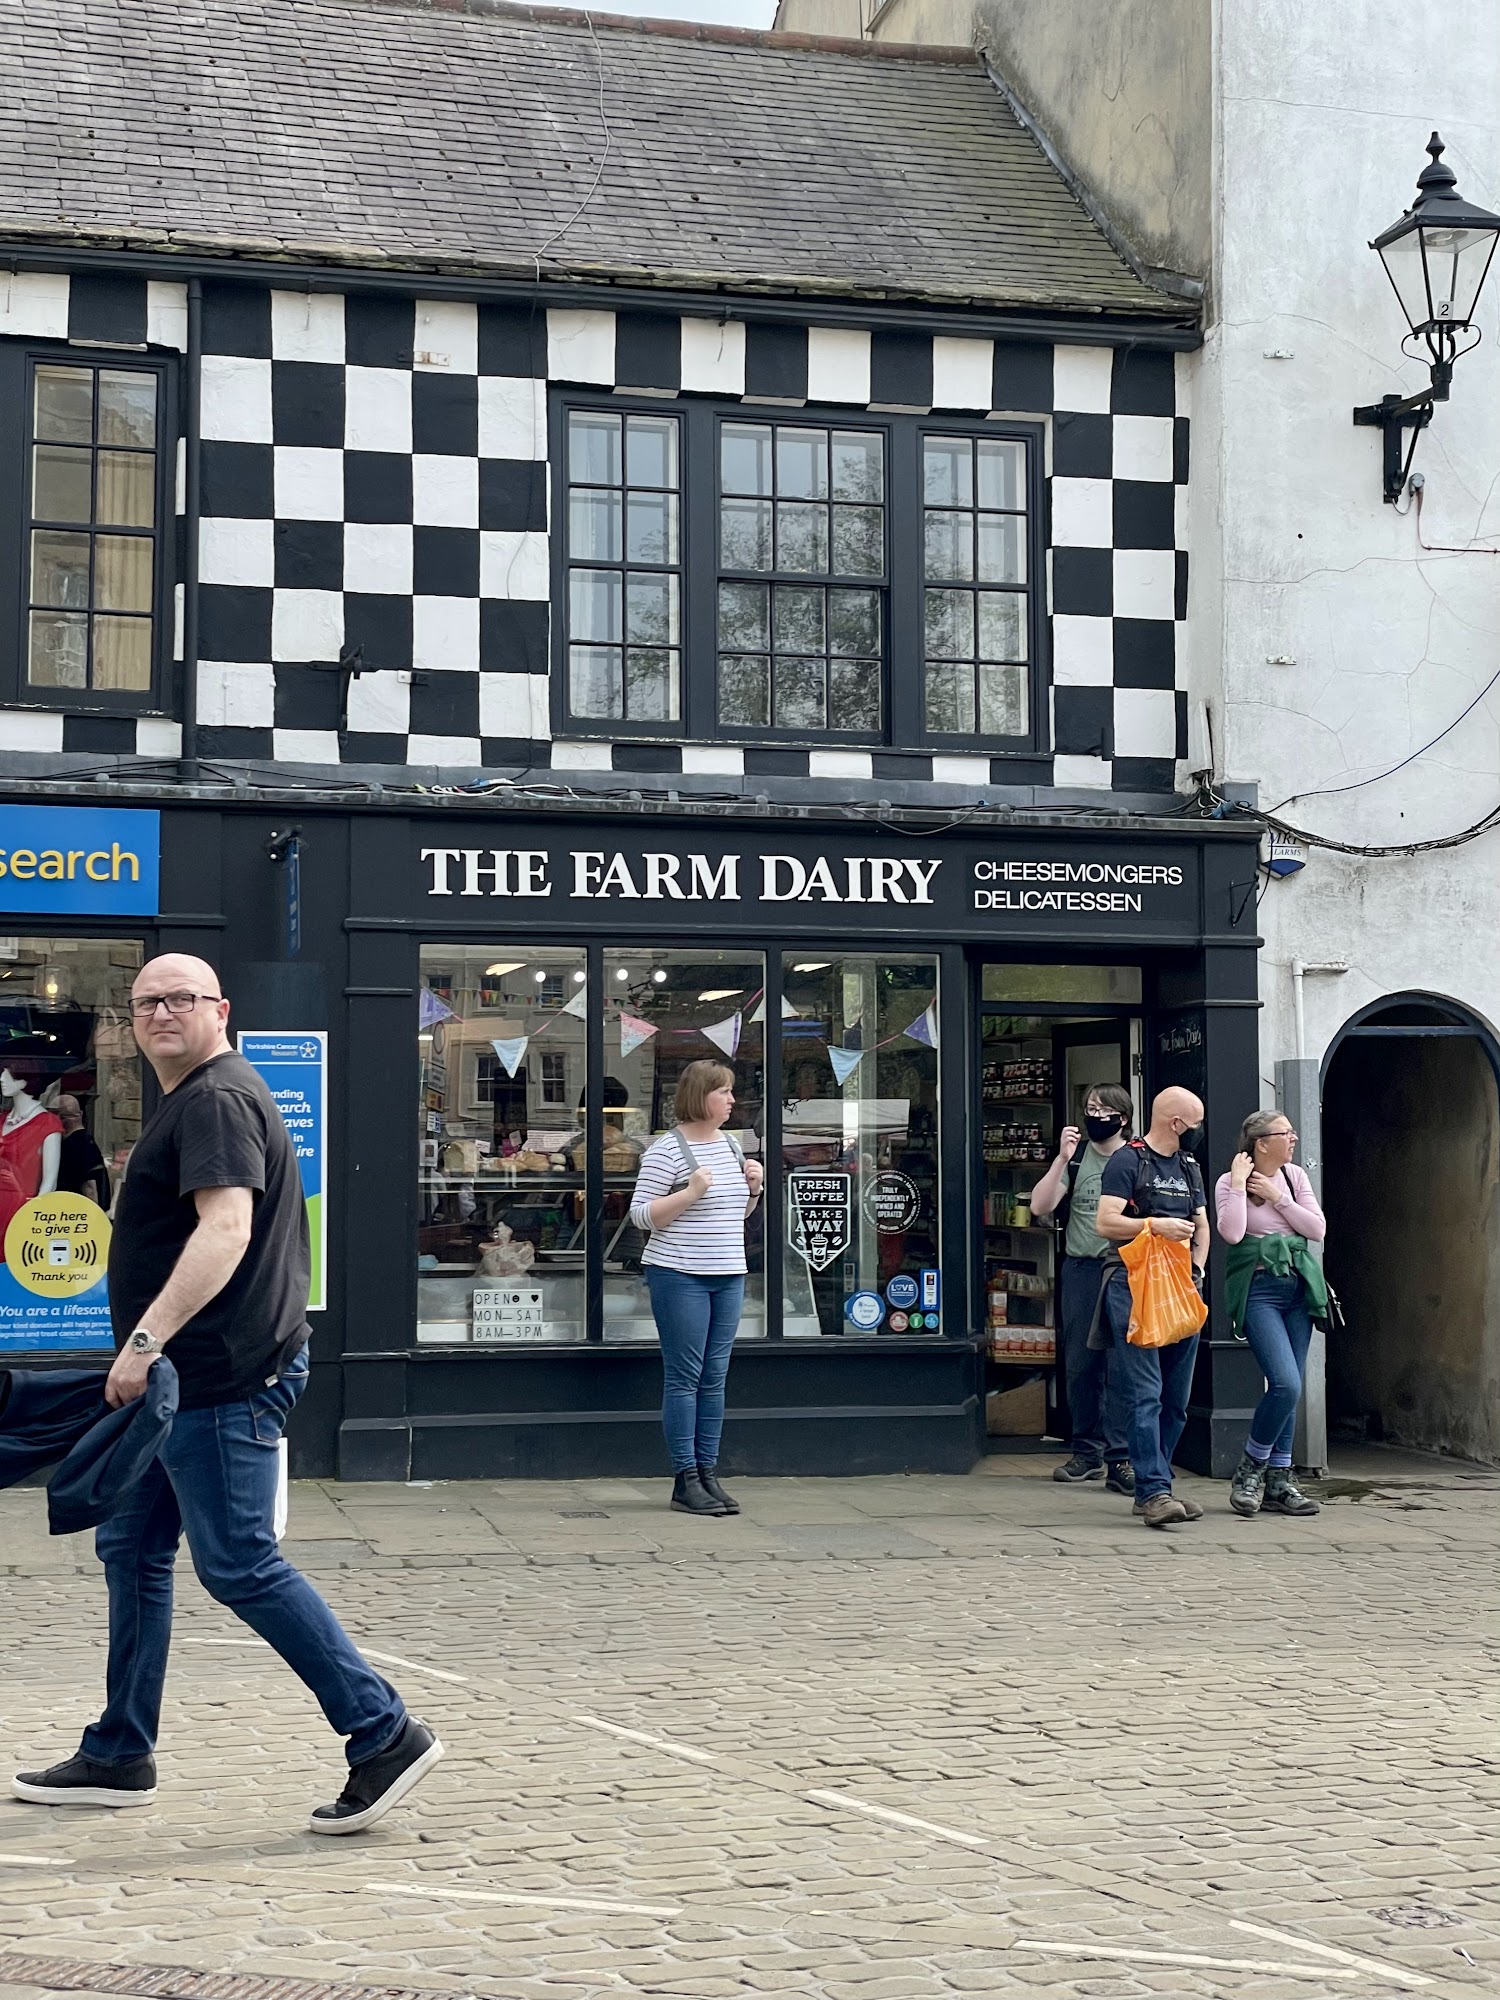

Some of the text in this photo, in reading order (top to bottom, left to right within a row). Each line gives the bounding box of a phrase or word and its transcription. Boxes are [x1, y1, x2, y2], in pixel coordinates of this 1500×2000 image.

[1440, 303, 1449, 316] 2
[421, 848, 943, 904] THE FARM DAIRY
[974, 861, 1183, 885] CHEESEMONGERS
[974, 890, 1142, 912] DELICATESSEN
[270, 1090, 304, 1100] nding
[277, 1101, 311, 1113] arch
[284, 1118, 314, 1128] aves
[293, 1133, 304, 1142] in
[296, 1145, 315, 1157] ire
[798, 1180, 841, 1190] FRESH
[795, 1192, 845, 1202] COFFEE
[33, 1211, 88, 1224] Tap here
[45, 1224, 70, 1237] give
[73, 1223, 88, 1234] £3
[794, 1220, 844, 1232] AWAY
[31, 1272, 88, 1283] Thank you
[474, 1293, 510, 1305] OPEN
[0, 1305, 111, 1317] You are a lifesave
